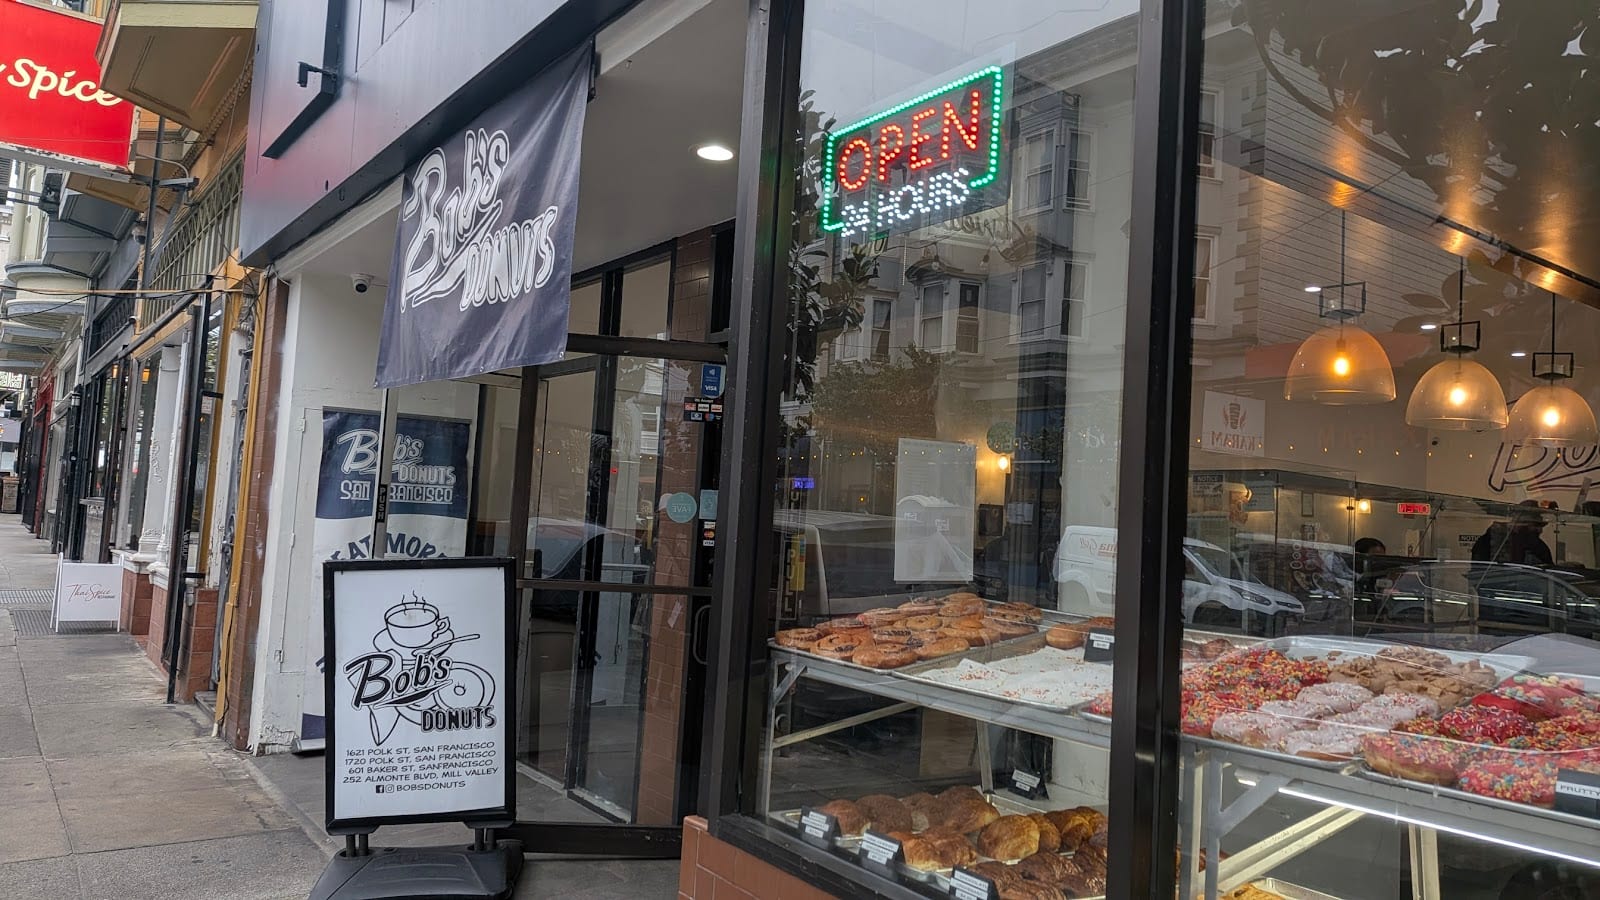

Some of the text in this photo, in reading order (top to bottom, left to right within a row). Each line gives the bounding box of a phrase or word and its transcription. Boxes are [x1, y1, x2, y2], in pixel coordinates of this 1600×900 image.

[7, 58, 123, 106] Spice
[839, 90, 982, 190] OPEN
[876, 166, 971, 226] HOURS
[402, 128, 510, 313] Bob's
[459, 206, 559, 312] DONUTS
[704, 384, 718, 392] VISA
[336, 429, 425, 474] Bb's
[397, 464, 457, 485] DONUTS
[340, 480, 453, 504] SAN RANCISCO
[377, 487, 387, 519] PUSH
[387, 532, 448, 558] MOR
[784, 548, 797, 613] PULL
[343, 652, 454, 710] Bob's
[421, 705, 498, 732] DONUTS
[345, 750, 496, 766] 1720 POLK ST, SAN FRANCISCO
[346, 741, 495, 757] 1621 POLK ST, SAN FRANCISCO
[342, 776, 362, 784] 252
[364, 774, 410, 783] ALMONTE
[442, 770, 462, 779] MILL
[464, 767, 499, 777] VALLEY
[348, 767, 364, 775] 601
[367, 765, 398, 774] BAKER
[396, 780, 466, 792] BOBSDONUTS
